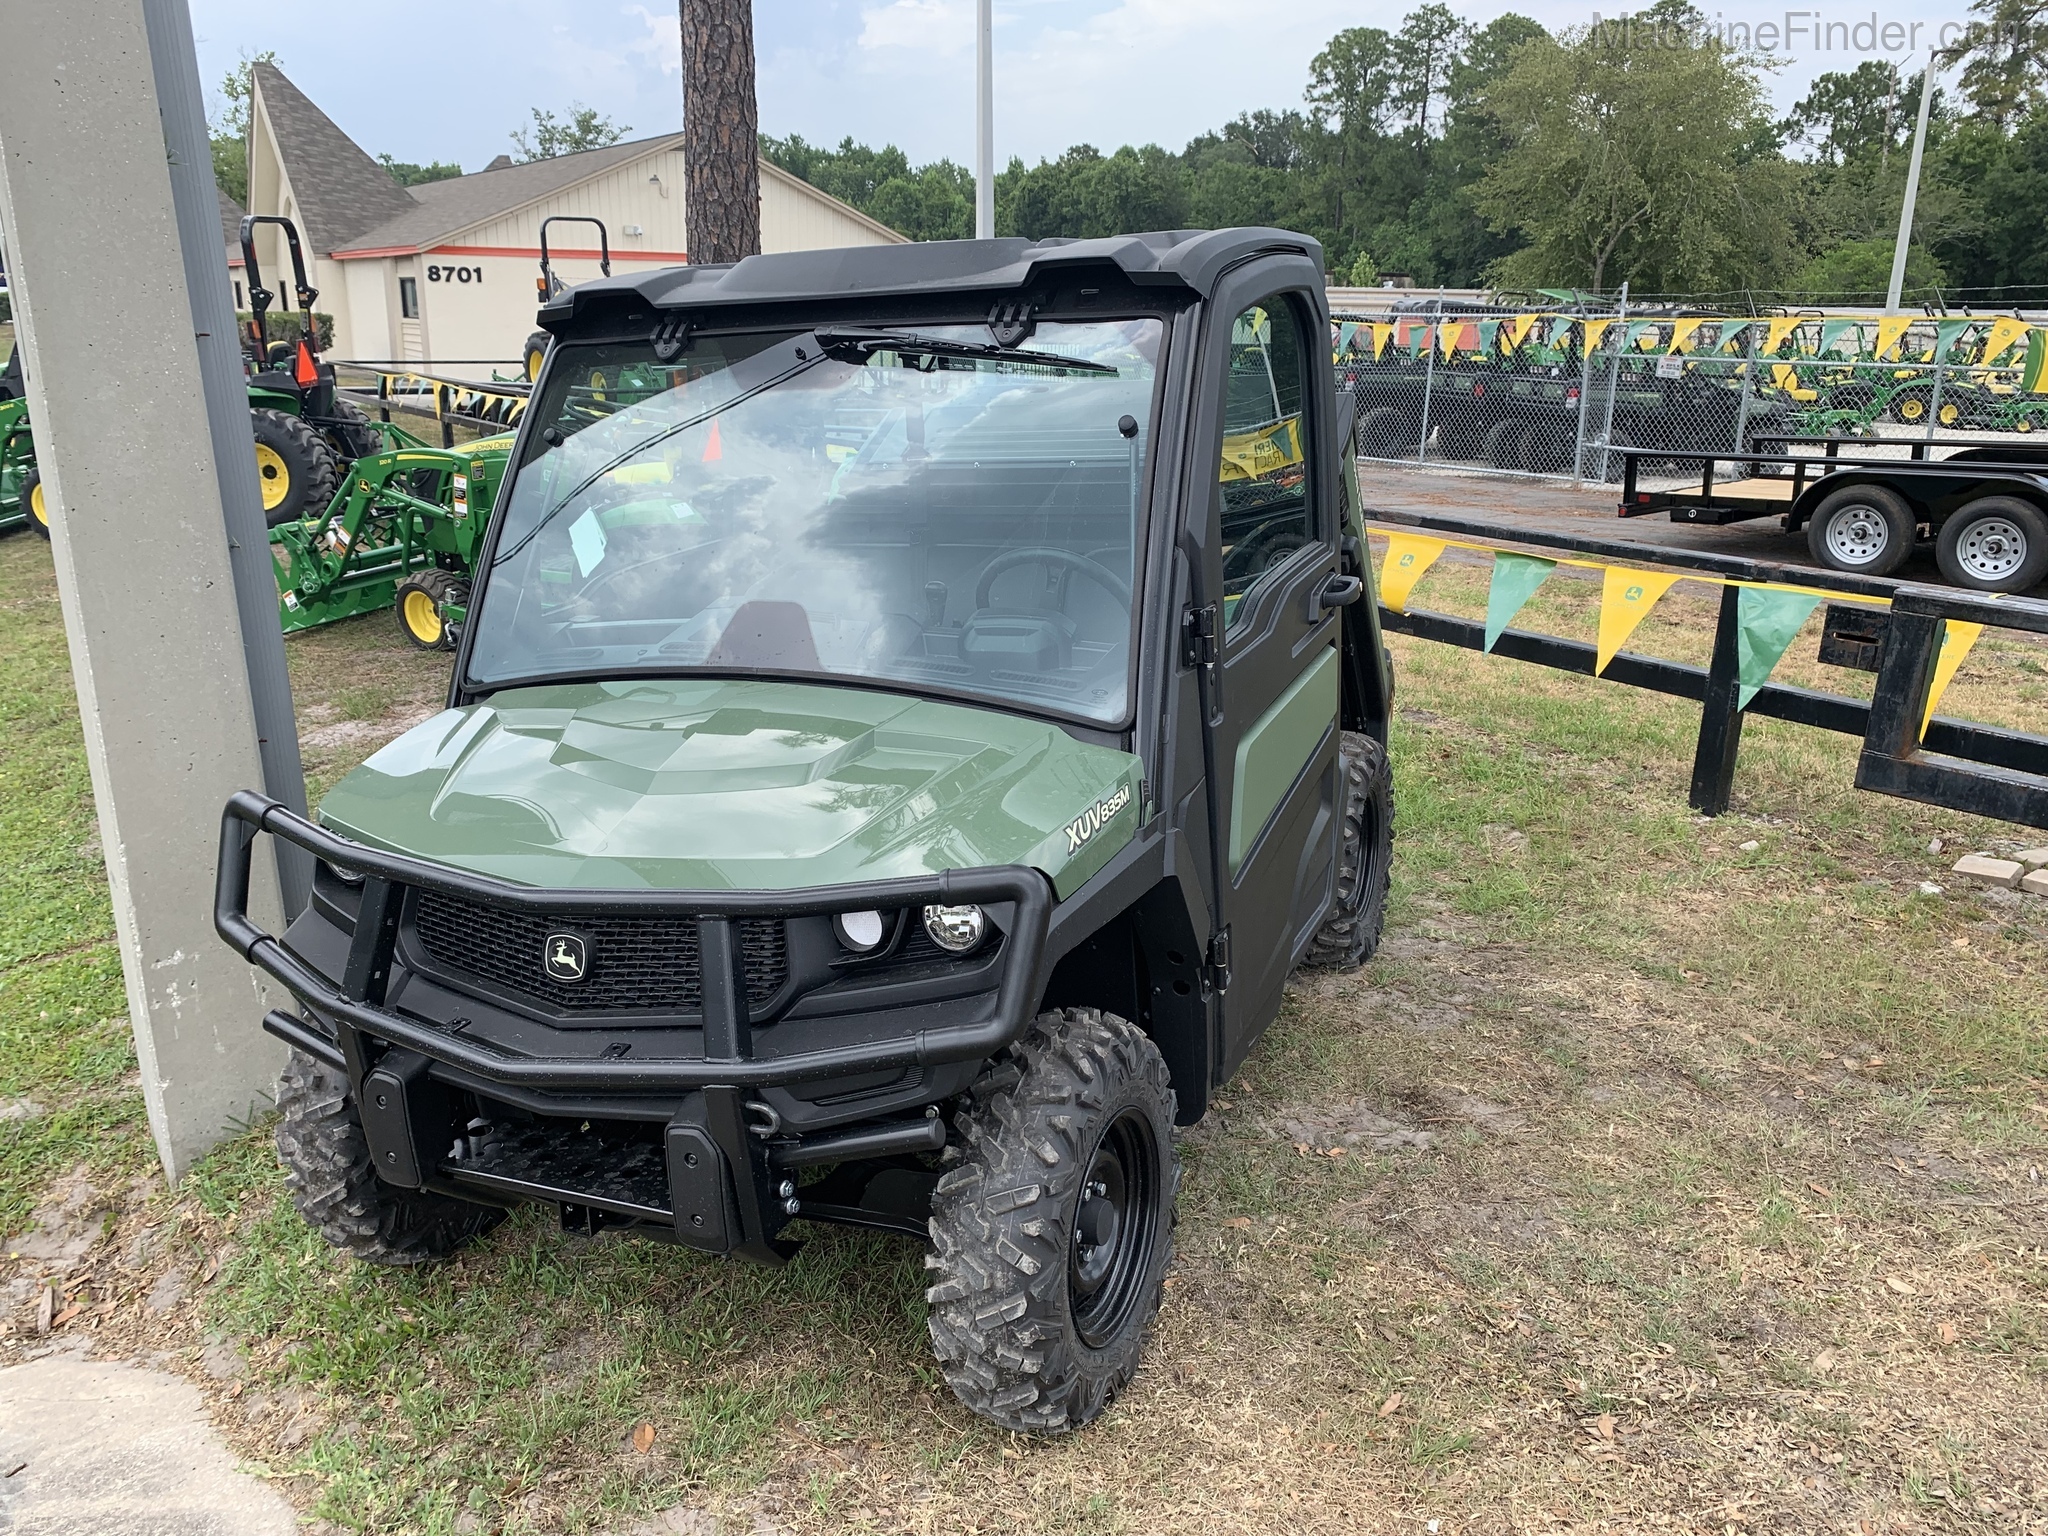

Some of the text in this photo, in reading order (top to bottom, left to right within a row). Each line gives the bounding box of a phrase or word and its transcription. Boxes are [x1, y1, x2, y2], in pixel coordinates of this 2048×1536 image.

[427, 265, 482, 283] 8701
[473, 443, 493, 451] JOHN
[1064, 783, 1131, 856] XUV835M
